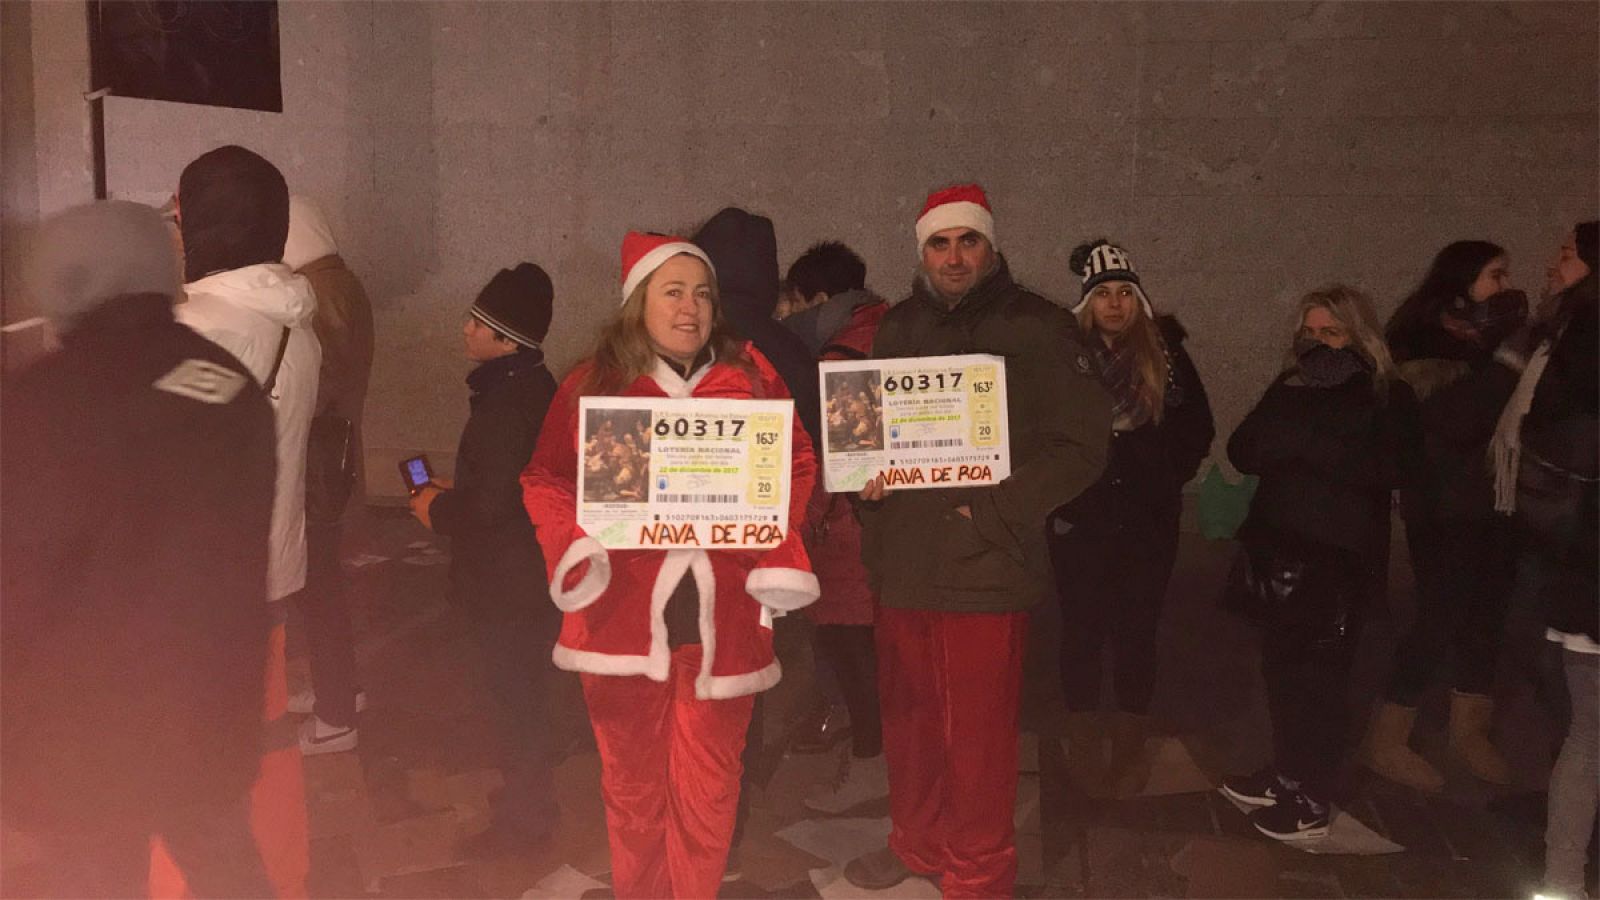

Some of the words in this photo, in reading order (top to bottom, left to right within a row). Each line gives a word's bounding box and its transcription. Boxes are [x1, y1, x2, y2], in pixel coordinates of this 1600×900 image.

[884, 372, 963, 392] 60317
[654, 418, 745, 437] 60317
[979, 425, 991, 435] 20
[880, 467, 925, 486] NAVA
[931, 467, 952, 483] DE
[958, 465, 992, 481] ROA
[758, 482, 771, 493] 20
[640, 523, 700, 546] NAVA
[711, 524, 736, 544] DE
[743, 523, 783, 544] ROA
